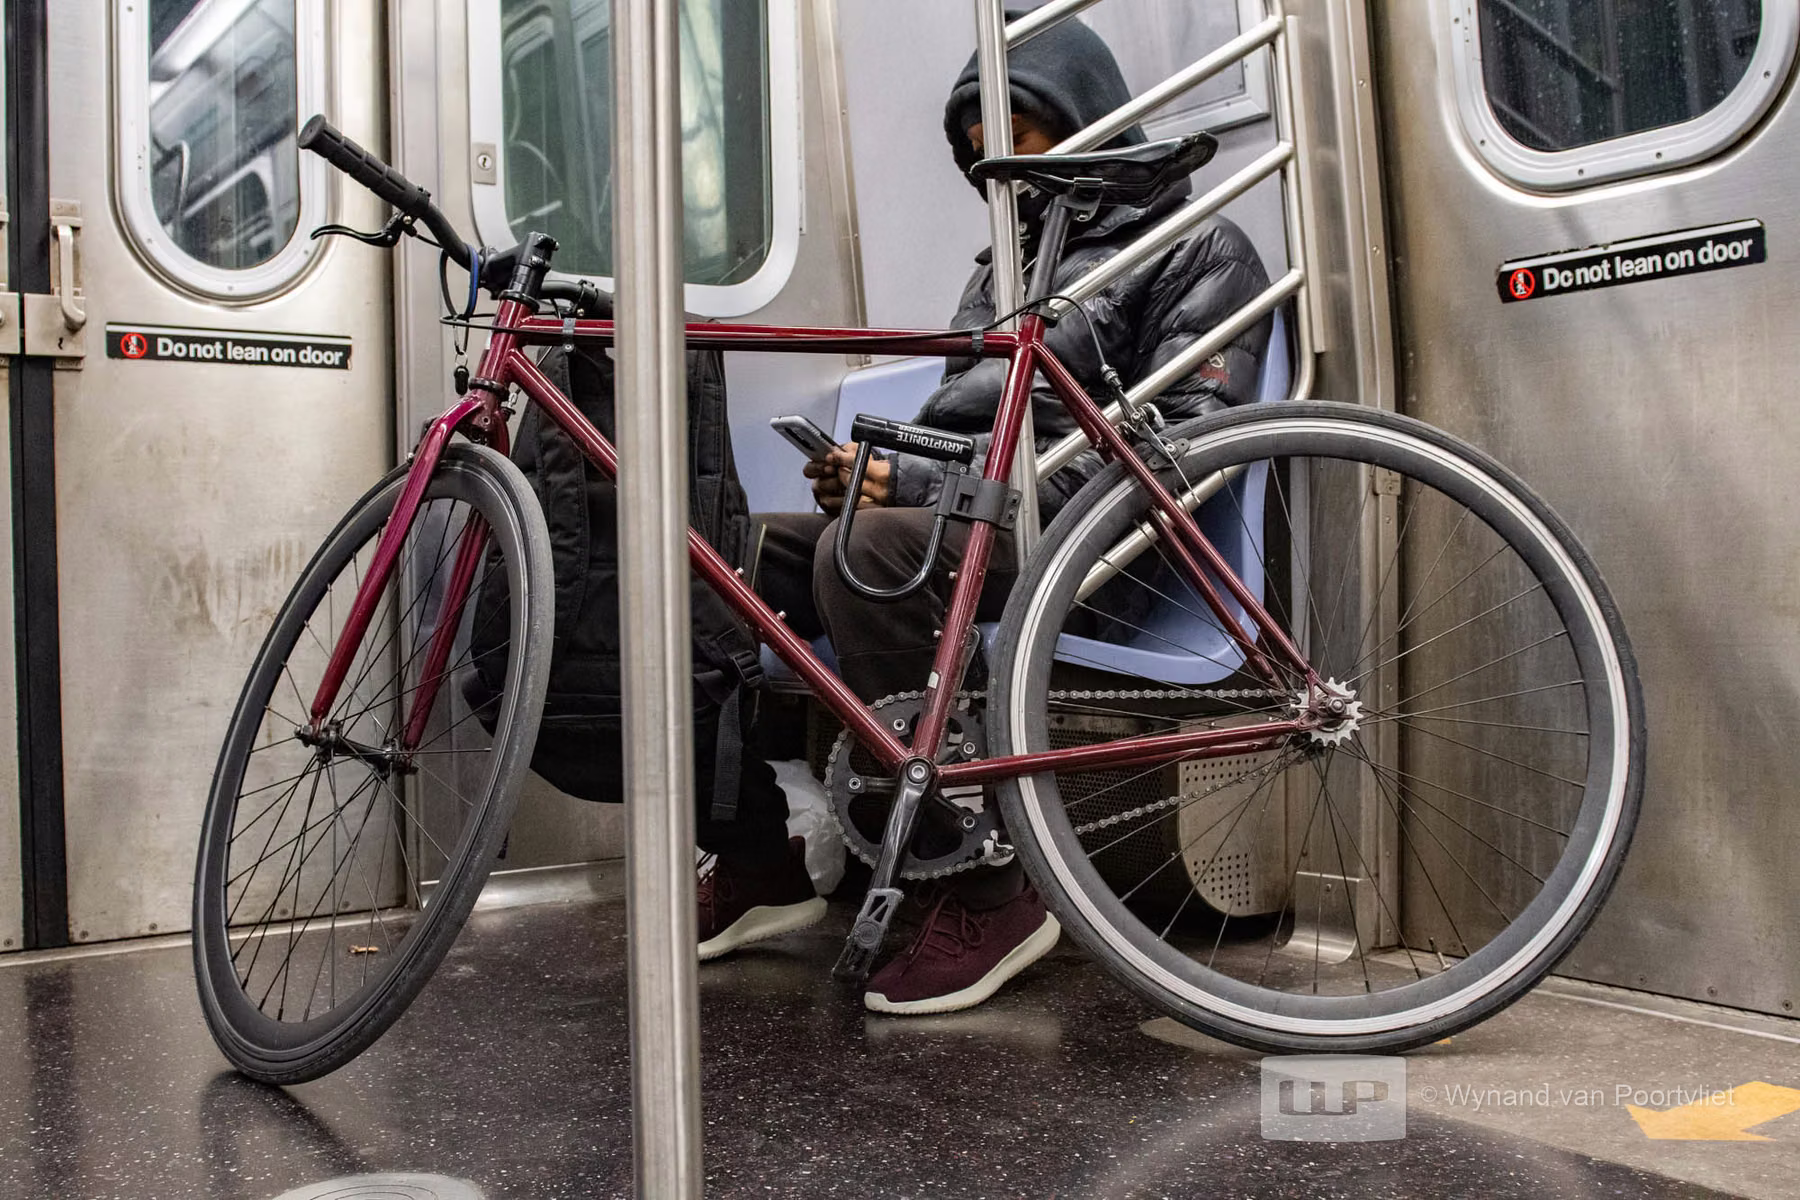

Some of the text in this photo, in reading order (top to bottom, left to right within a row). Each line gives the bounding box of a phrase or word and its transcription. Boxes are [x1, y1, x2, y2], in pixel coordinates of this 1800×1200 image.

[1542, 238, 1753, 291] Do not lean on door
[157, 337, 344, 366] Do not lean on door
[896, 431, 964, 454] KRYPTONITE
